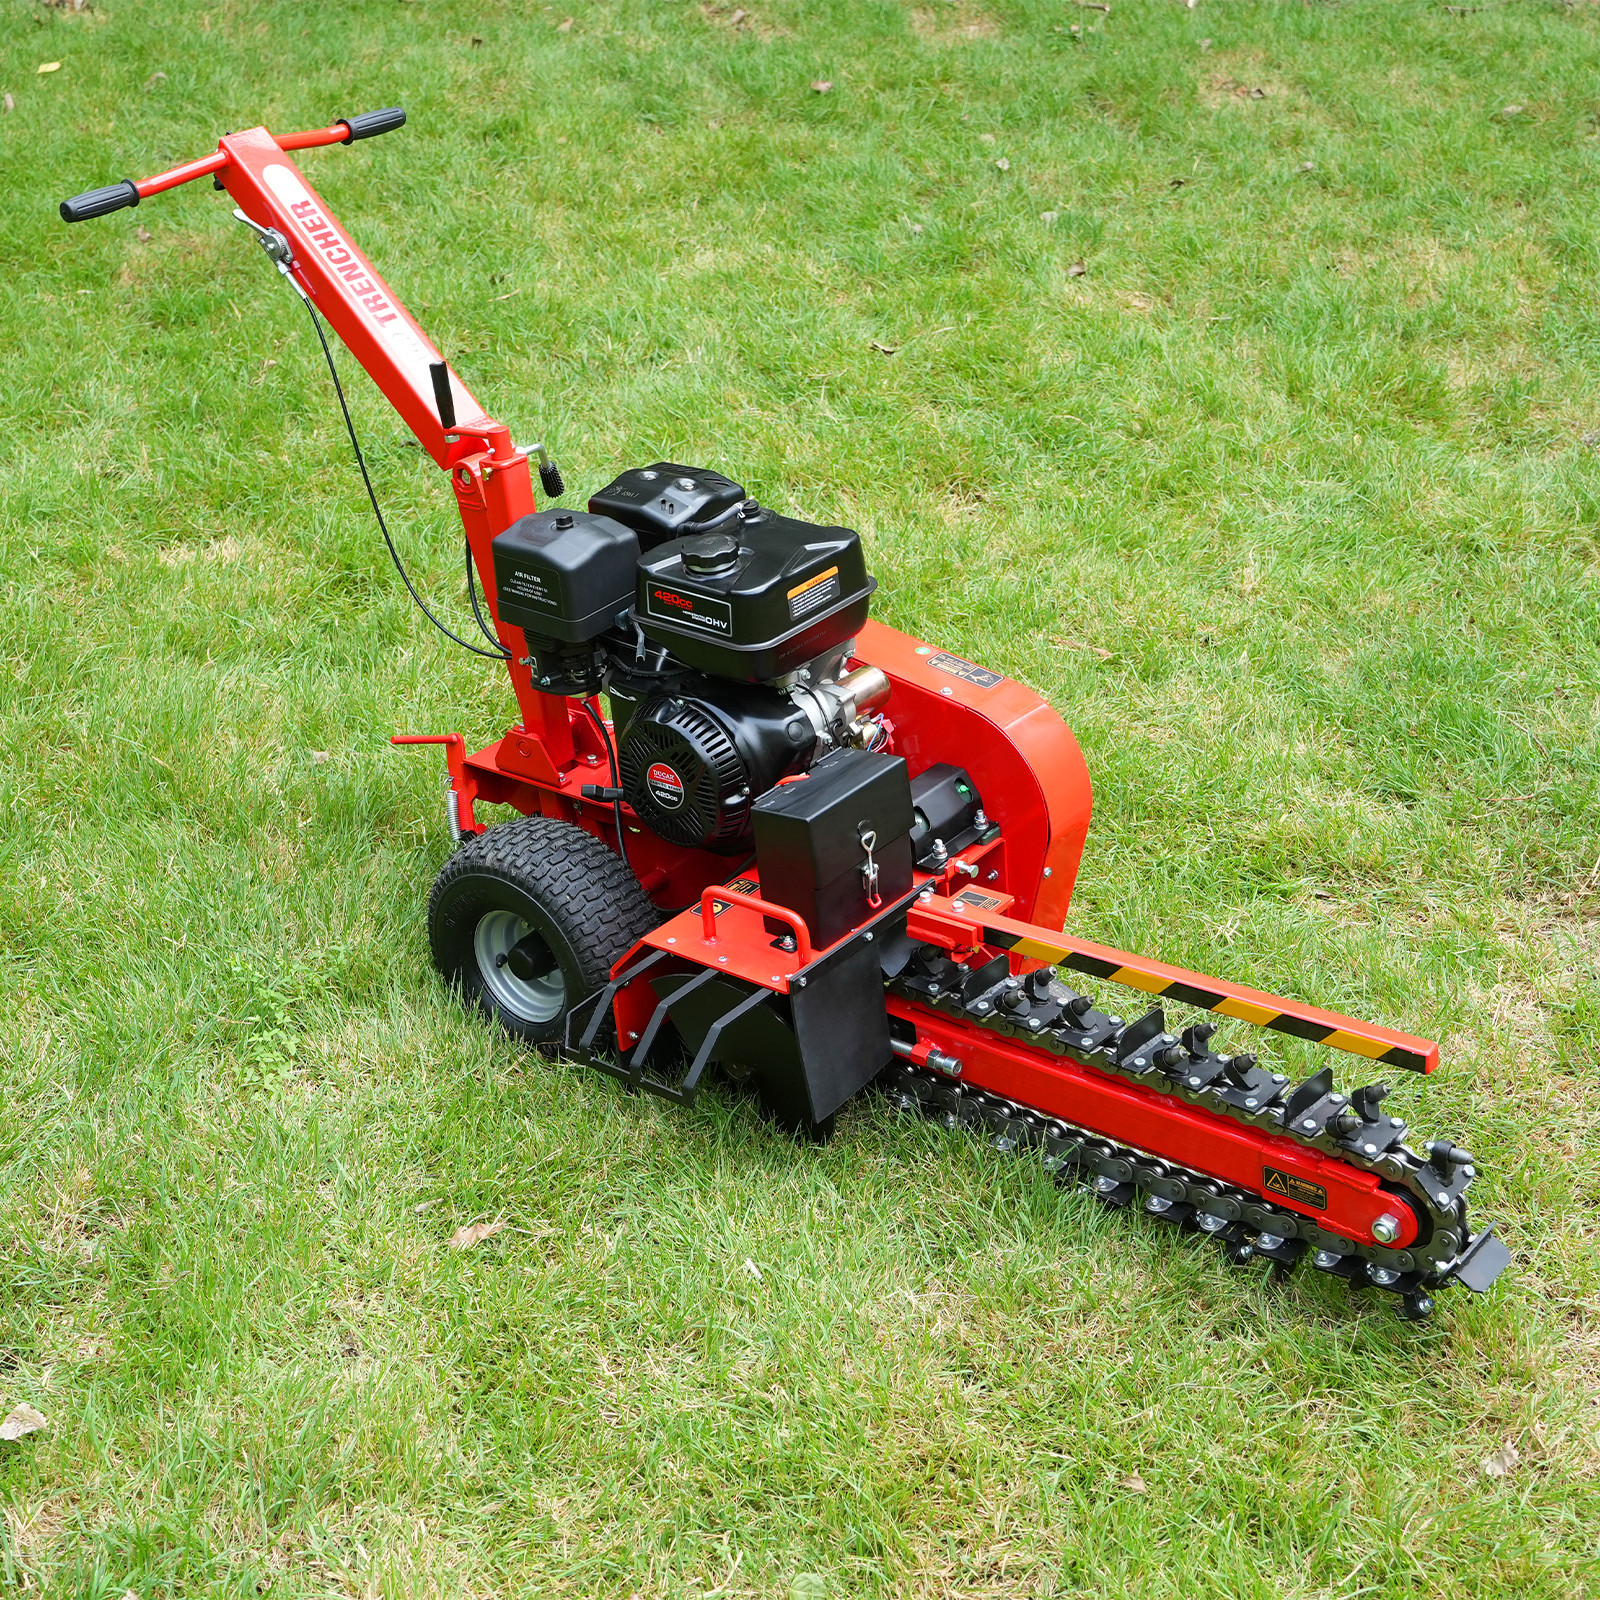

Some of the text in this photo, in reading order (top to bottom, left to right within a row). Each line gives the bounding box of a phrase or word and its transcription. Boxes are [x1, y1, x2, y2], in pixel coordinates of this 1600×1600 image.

[290, 199, 398, 328] TRENCHER
[654, 590, 693, 608] 420cc
[705, 616, 728, 629] OHV
